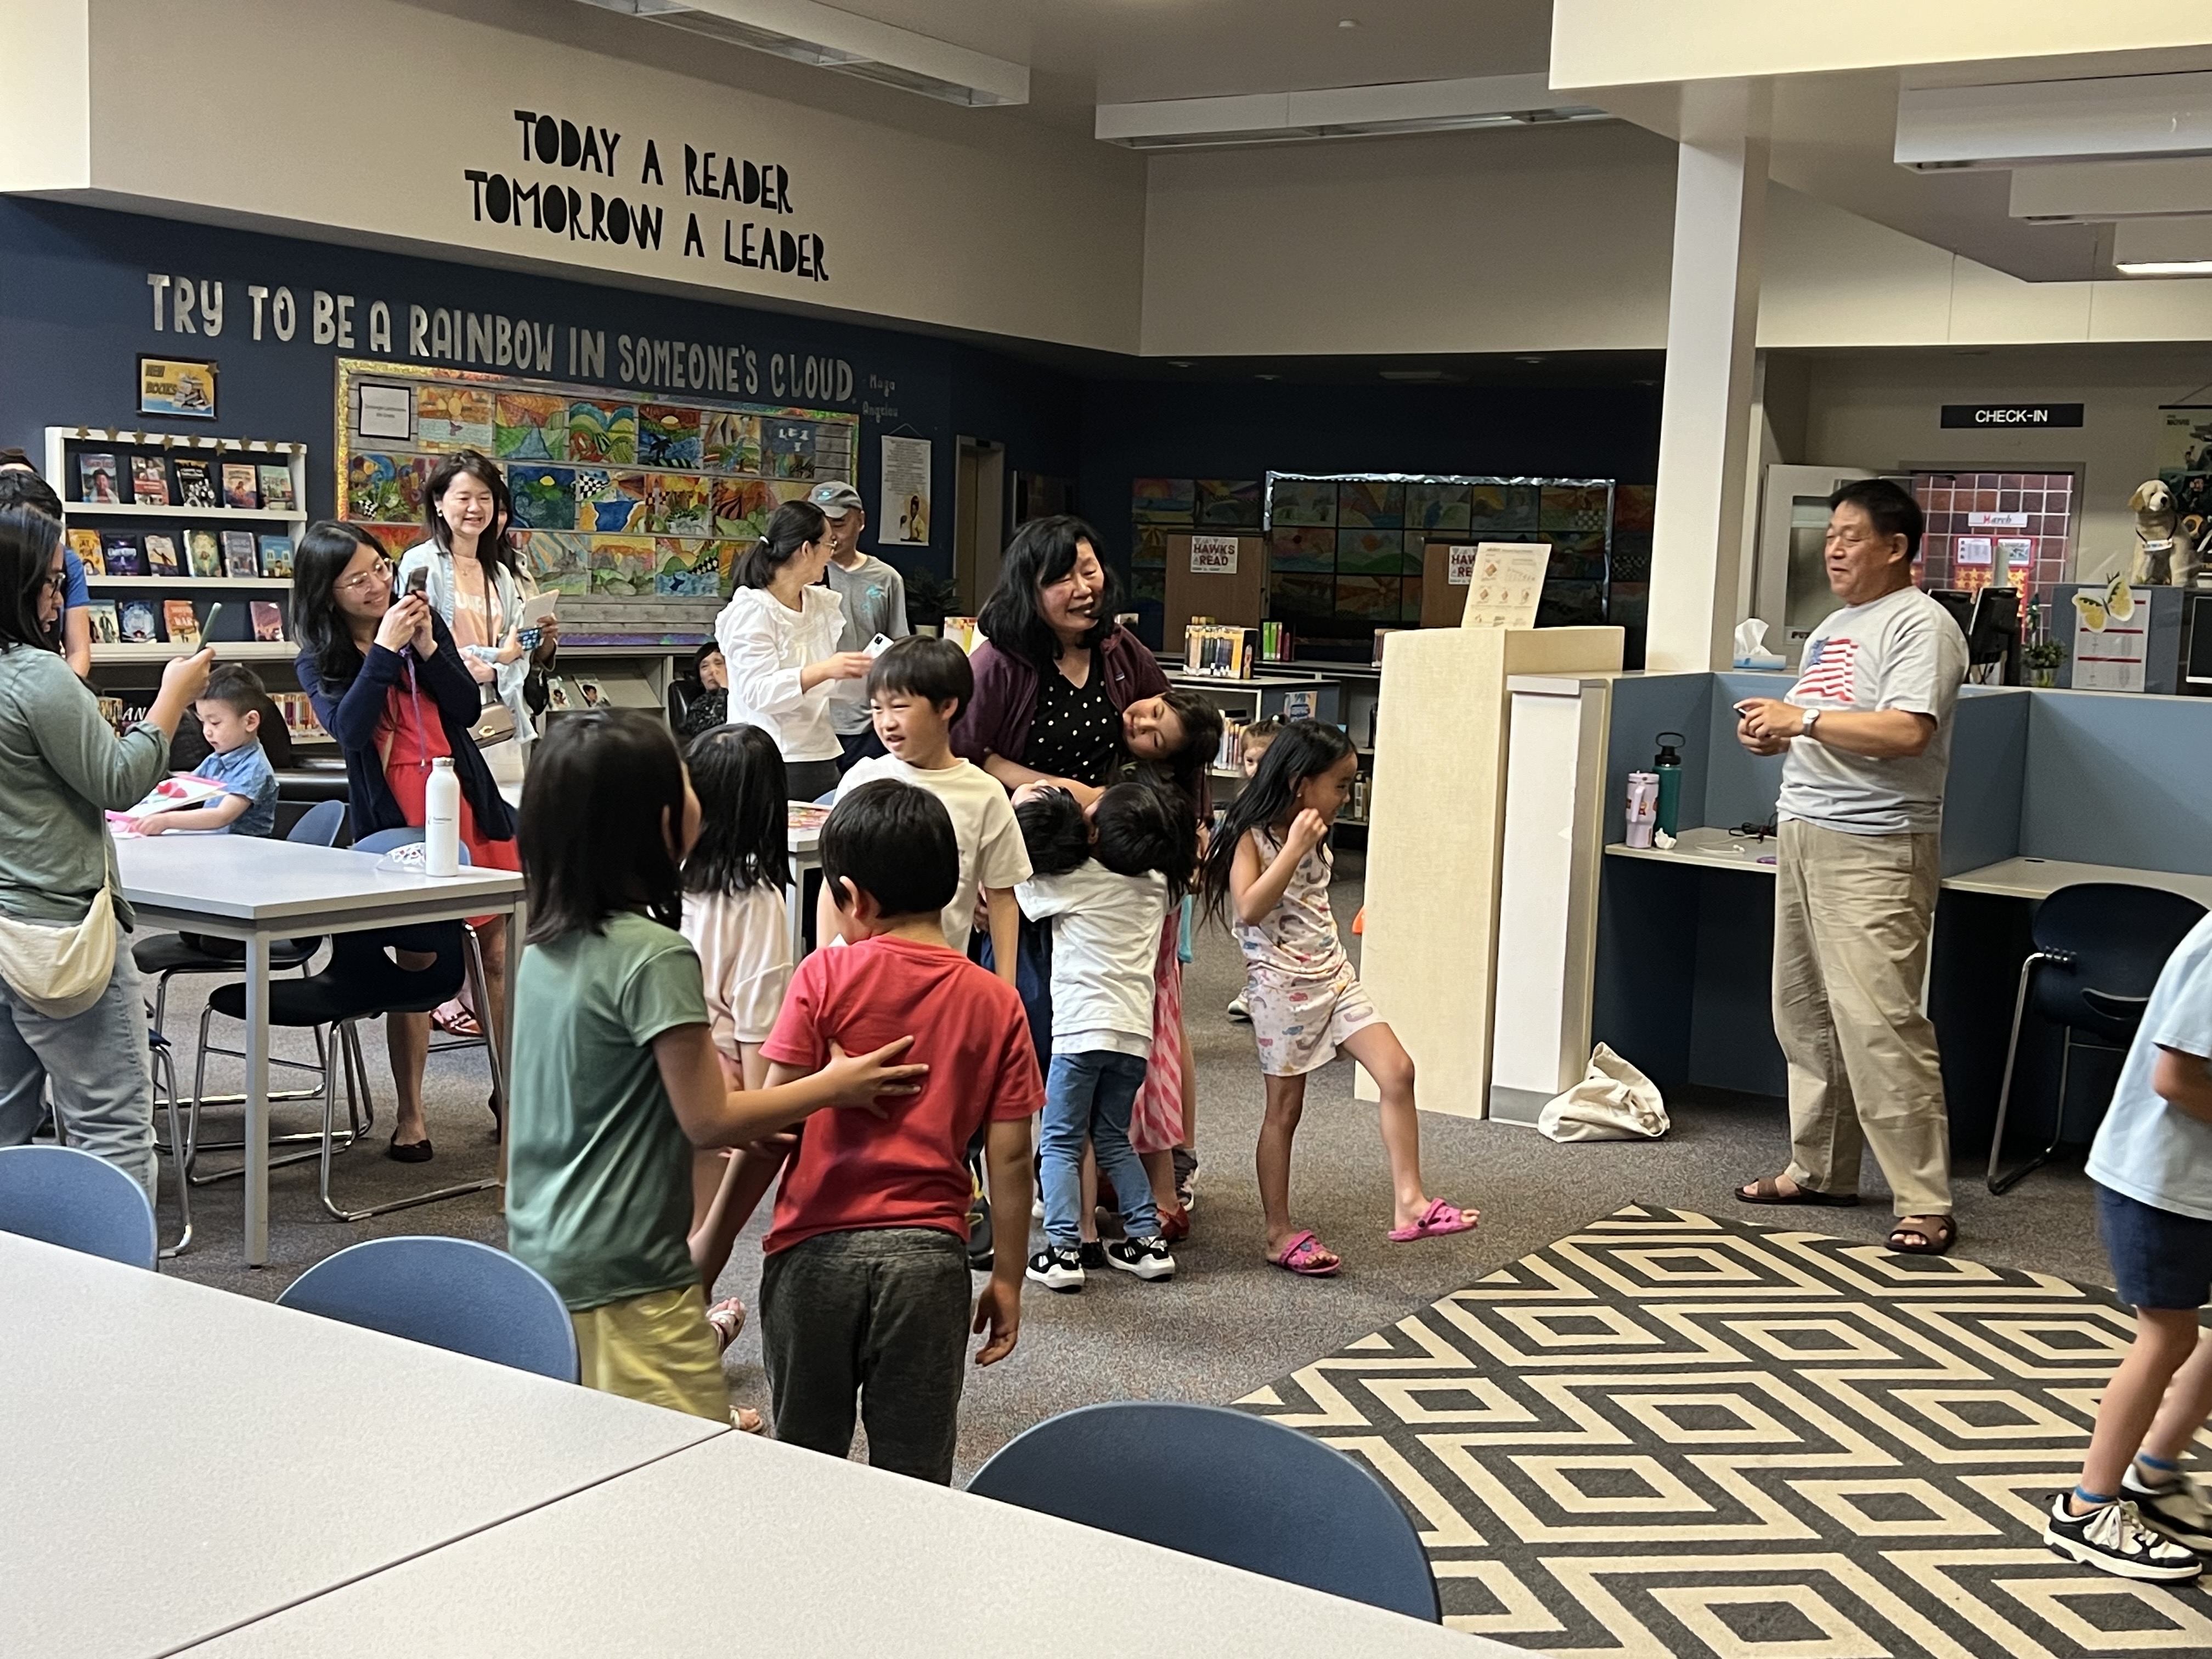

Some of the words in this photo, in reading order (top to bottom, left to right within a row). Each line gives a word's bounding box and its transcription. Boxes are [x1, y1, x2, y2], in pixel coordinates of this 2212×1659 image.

[515, 110, 621, 177] TODAY
[641, 139, 663, 186] A
[684, 143, 793, 215] READER
[465, 170, 663, 251] TOMORROW
[684, 213, 705, 258] A
[724, 219, 829, 283] LEADER
[146, 273, 223, 337] TRY
[248, 285, 296, 342] TO
[313, 290, 356, 349] BE
[370, 301, 392, 353] A
[409, 304, 554, 372] RAINBOW
[569, 326, 606, 379] IN
[618, 334, 758, 394] SOMEONE'S
[1975, 409, 2048, 423] CHECK-IN
[1194, 544, 1235, 555] HAWKS
[1200, 555, 1228, 566] READ
[1451, 555, 1476, 565] HAW
[1457, 567, 1472, 577] RE
